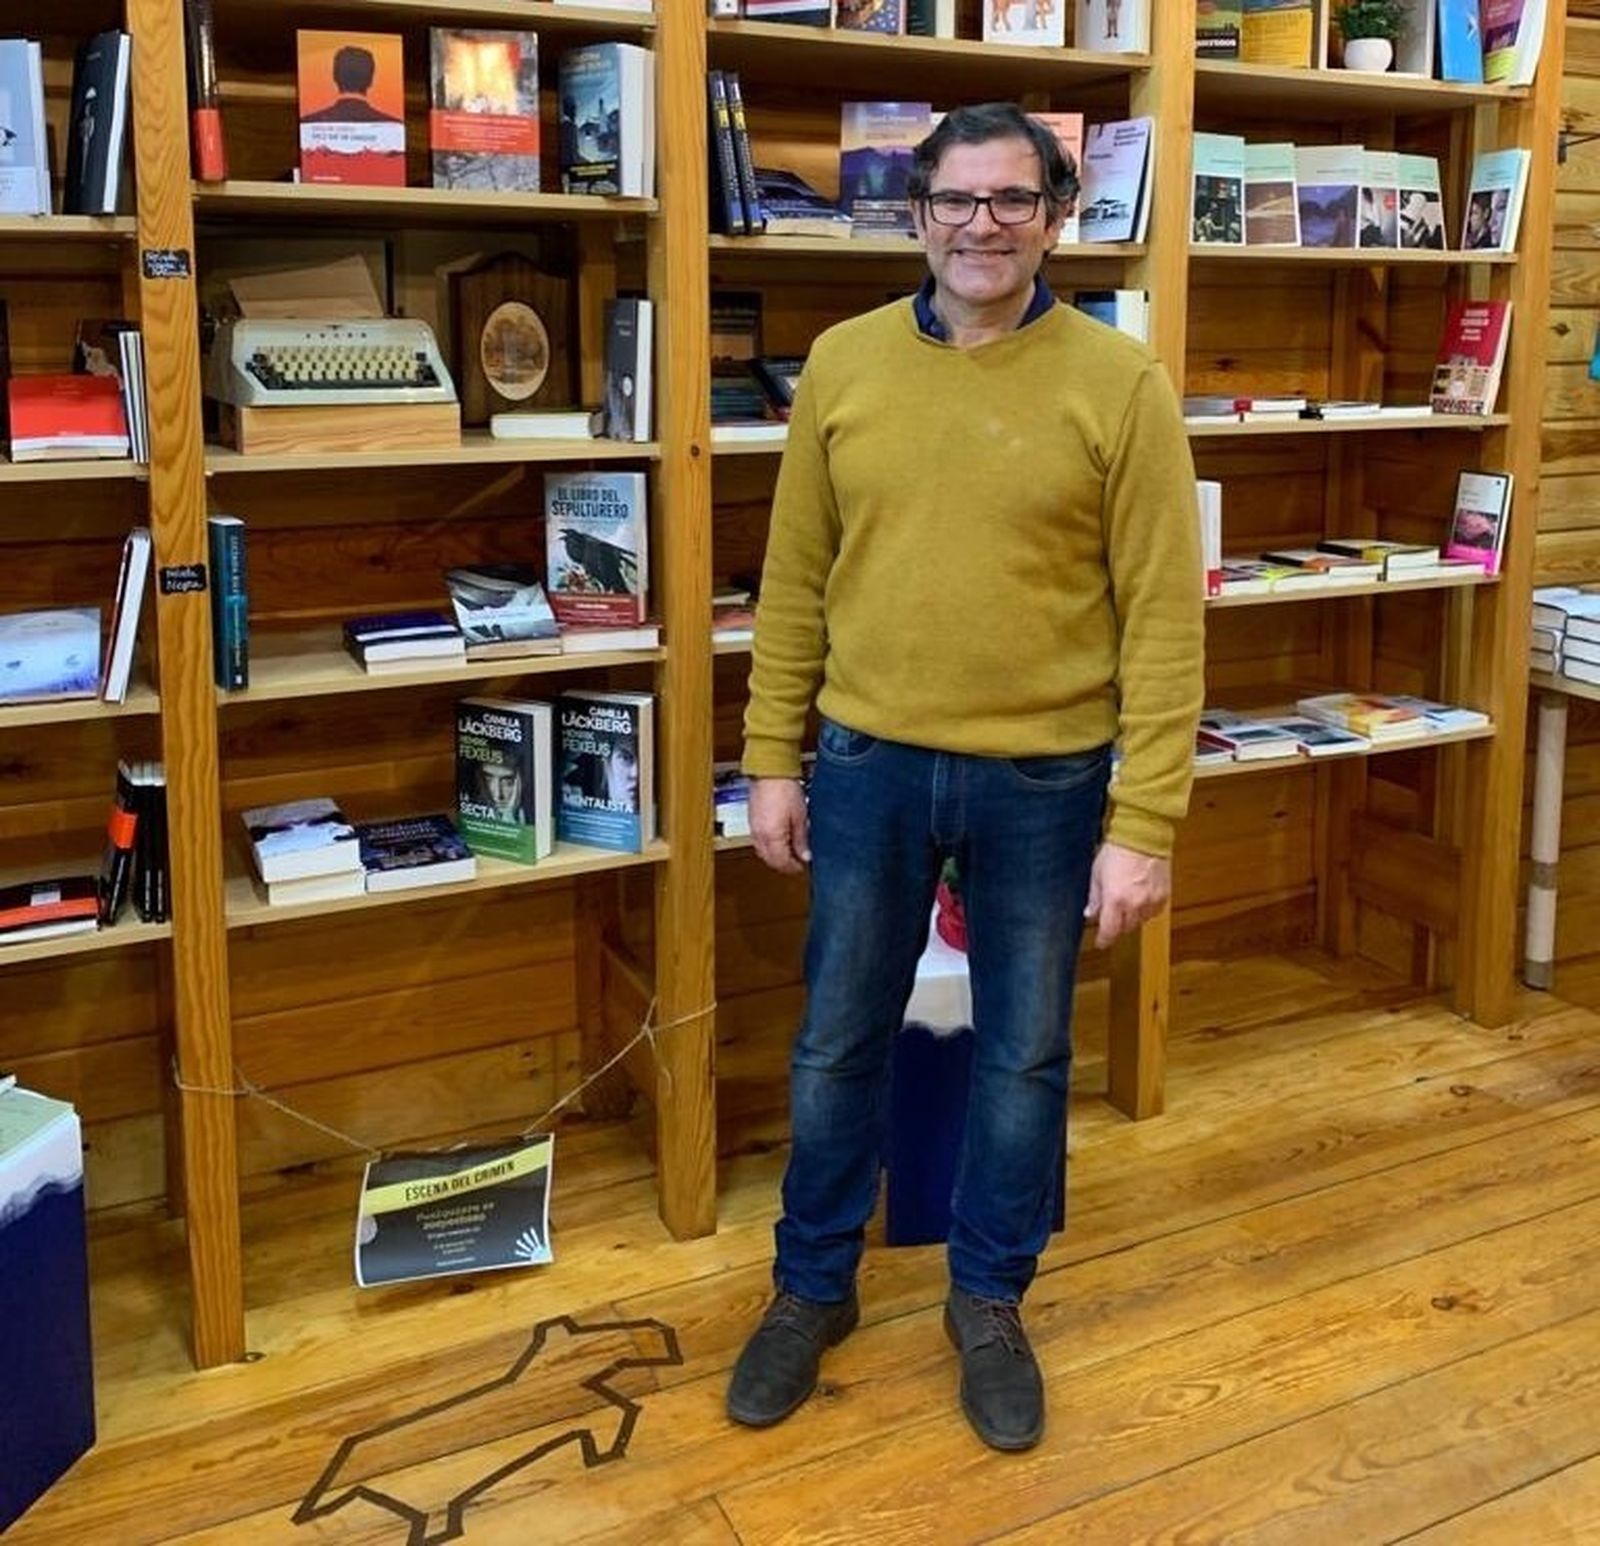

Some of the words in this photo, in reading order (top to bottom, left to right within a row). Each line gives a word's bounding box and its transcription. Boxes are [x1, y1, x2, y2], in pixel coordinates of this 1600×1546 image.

[558, 487, 569, 501] EL
[571, 488, 599, 501] LIBRO
[601, 489, 621, 502] DEL
[552, 500, 629, 519] SEPULTURERO
[482, 713, 521, 728] CAMILLA
[589, 706, 631, 721] CAMILLA
[459, 801, 497, 820] SECTA
[405, 1182, 449, 1201] ESCENA
[451, 1177, 471, 1191] DEL
[474, 1161, 515, 1184] CRIMEN
